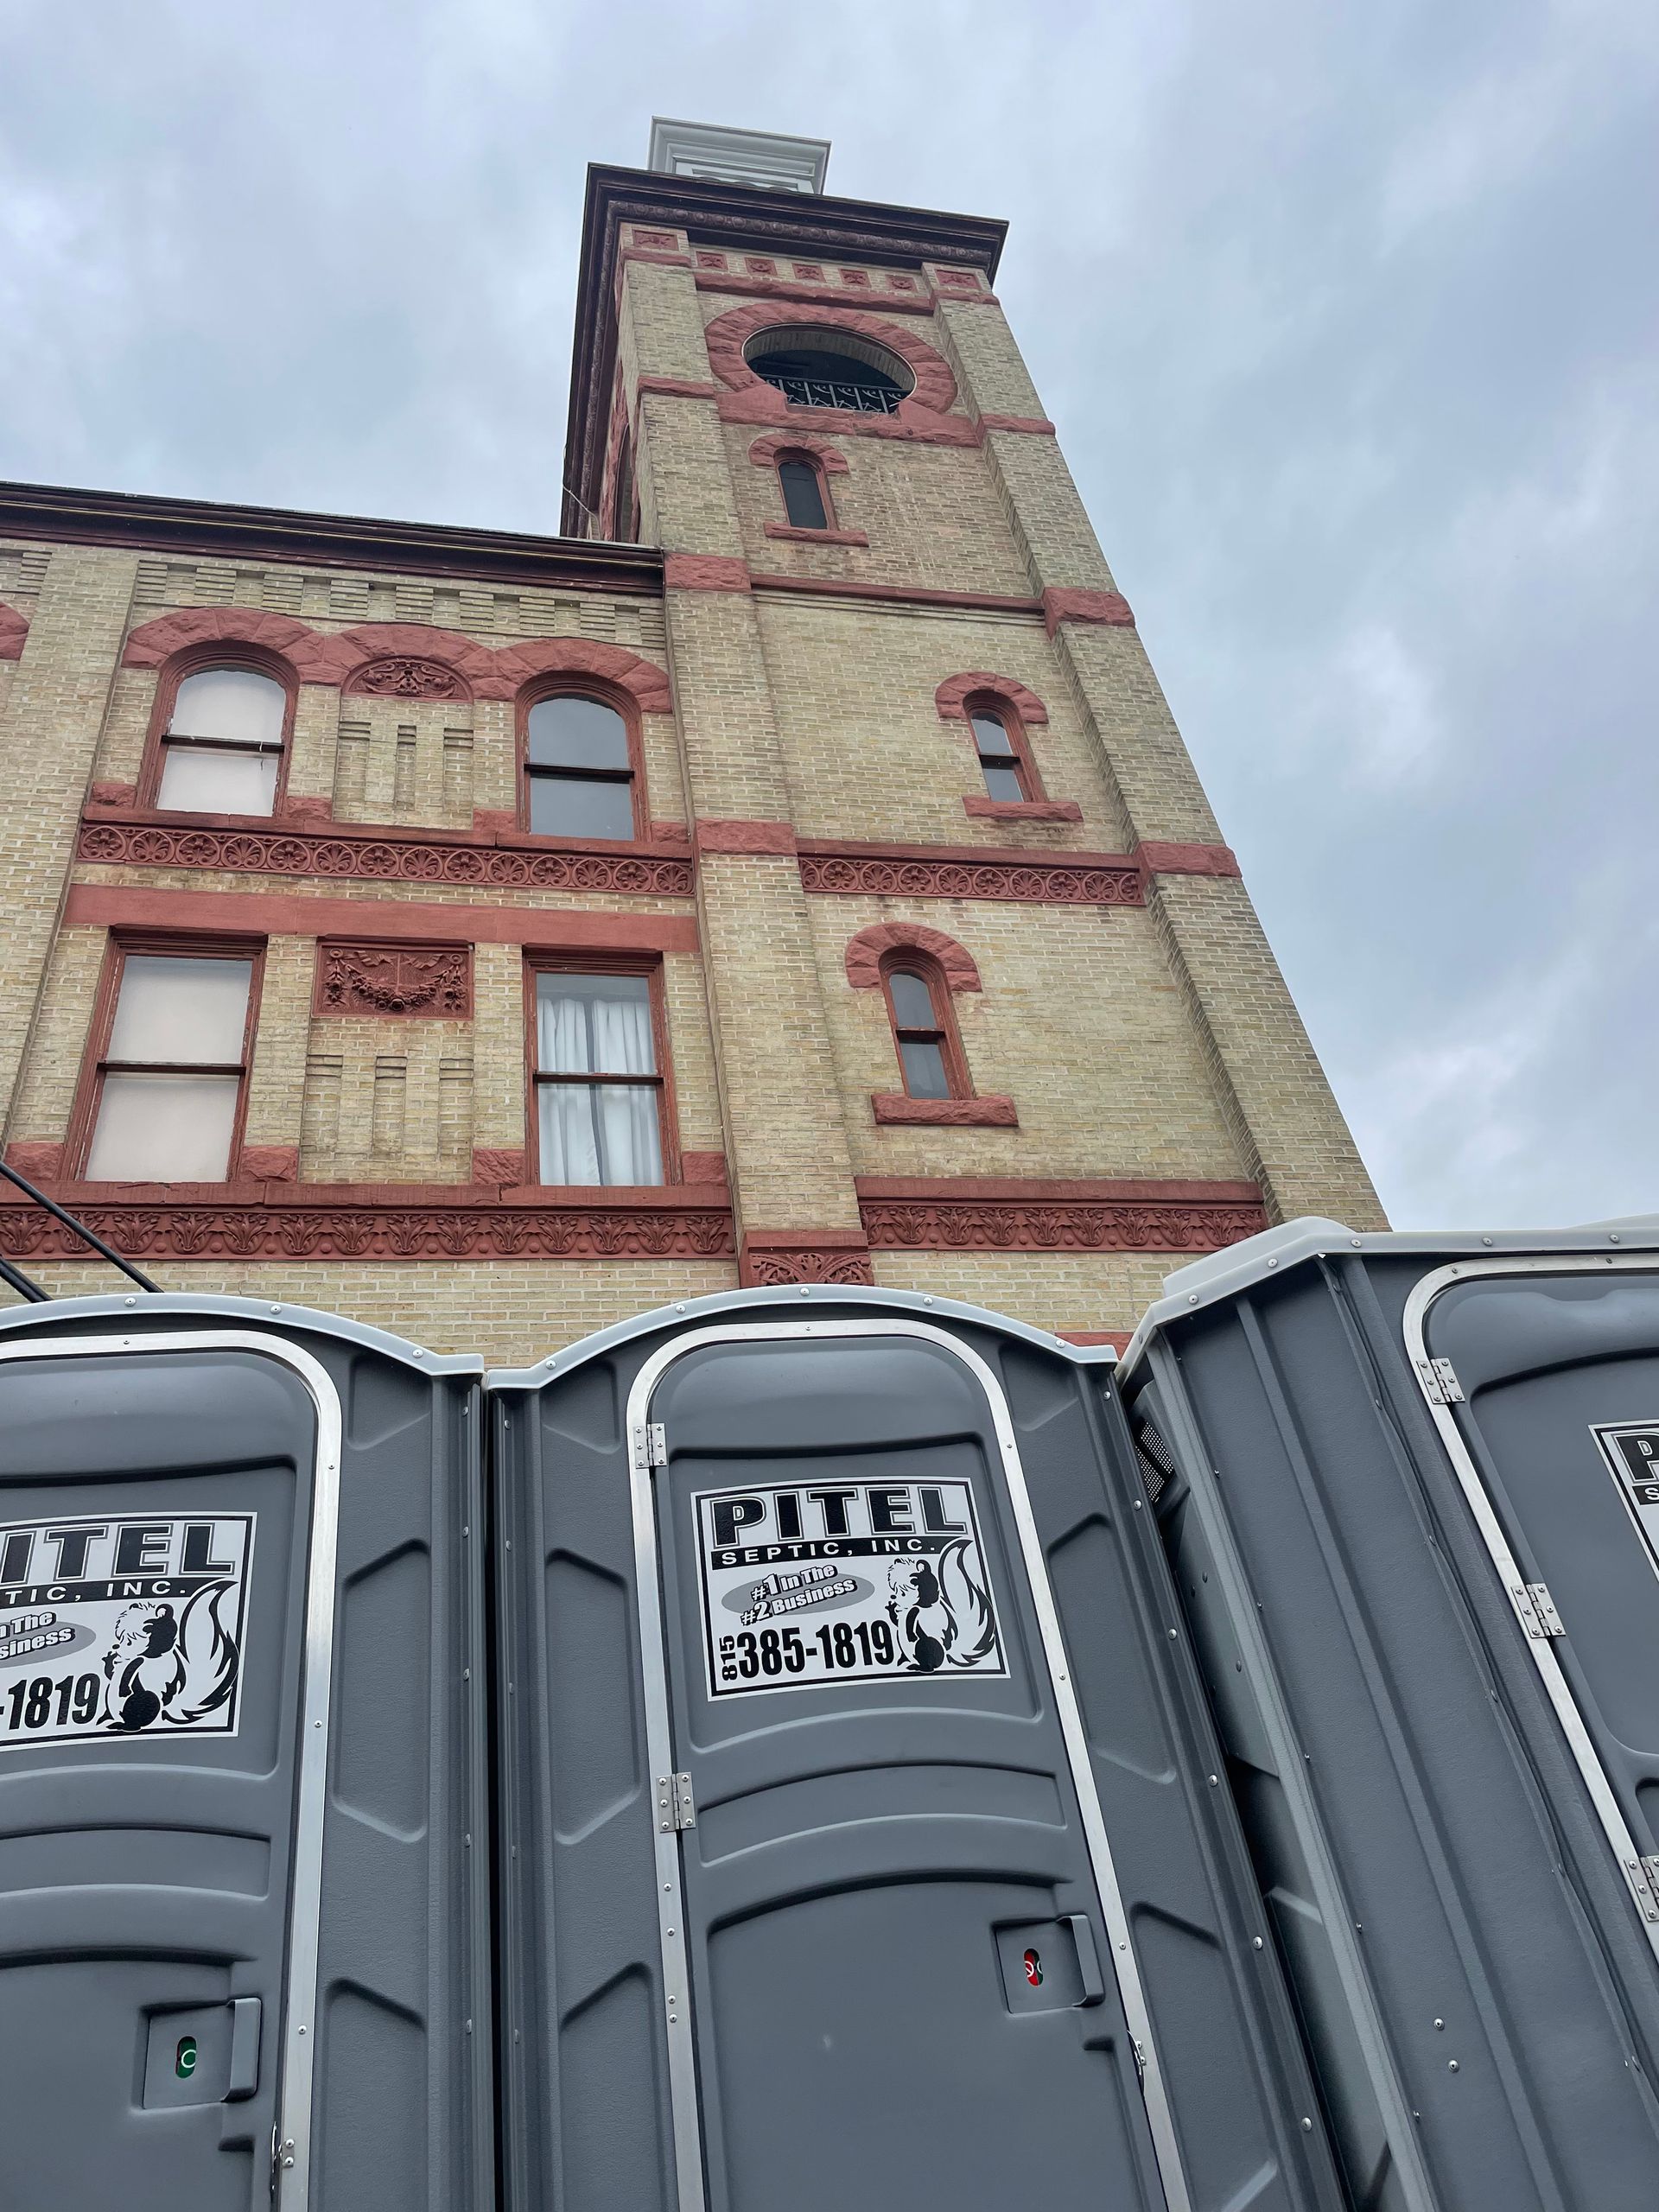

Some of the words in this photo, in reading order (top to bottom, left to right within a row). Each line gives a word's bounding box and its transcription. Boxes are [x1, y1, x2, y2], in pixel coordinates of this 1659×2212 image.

[709, 1486, 969, 1549] PITEL
[0, 1522, 235, 1586] ITEL
[721, 1541, 854, 1566] SEPTIC,
[871, 1538, 935, 1554] INC.
[4, 1586, 82, 1605] TIC,
[106, 1580, 186, 1597] INC.
[740, 1600, 773, 1625] #2
[771, 1579, 857, 1615] Business
[750, 1573, 781, 1601] #1
[779, 1574, 804, 1592] In
[800, 1564, 838, 1585] The
[0, 1627, 75, 1661] siness
[10, 1611, 56, 1636] The
[719, 1635, 738, 1681] 815
[737, 1620, 895, 1678] 385-1819
[0, 1673, 101, 1731] 1819
